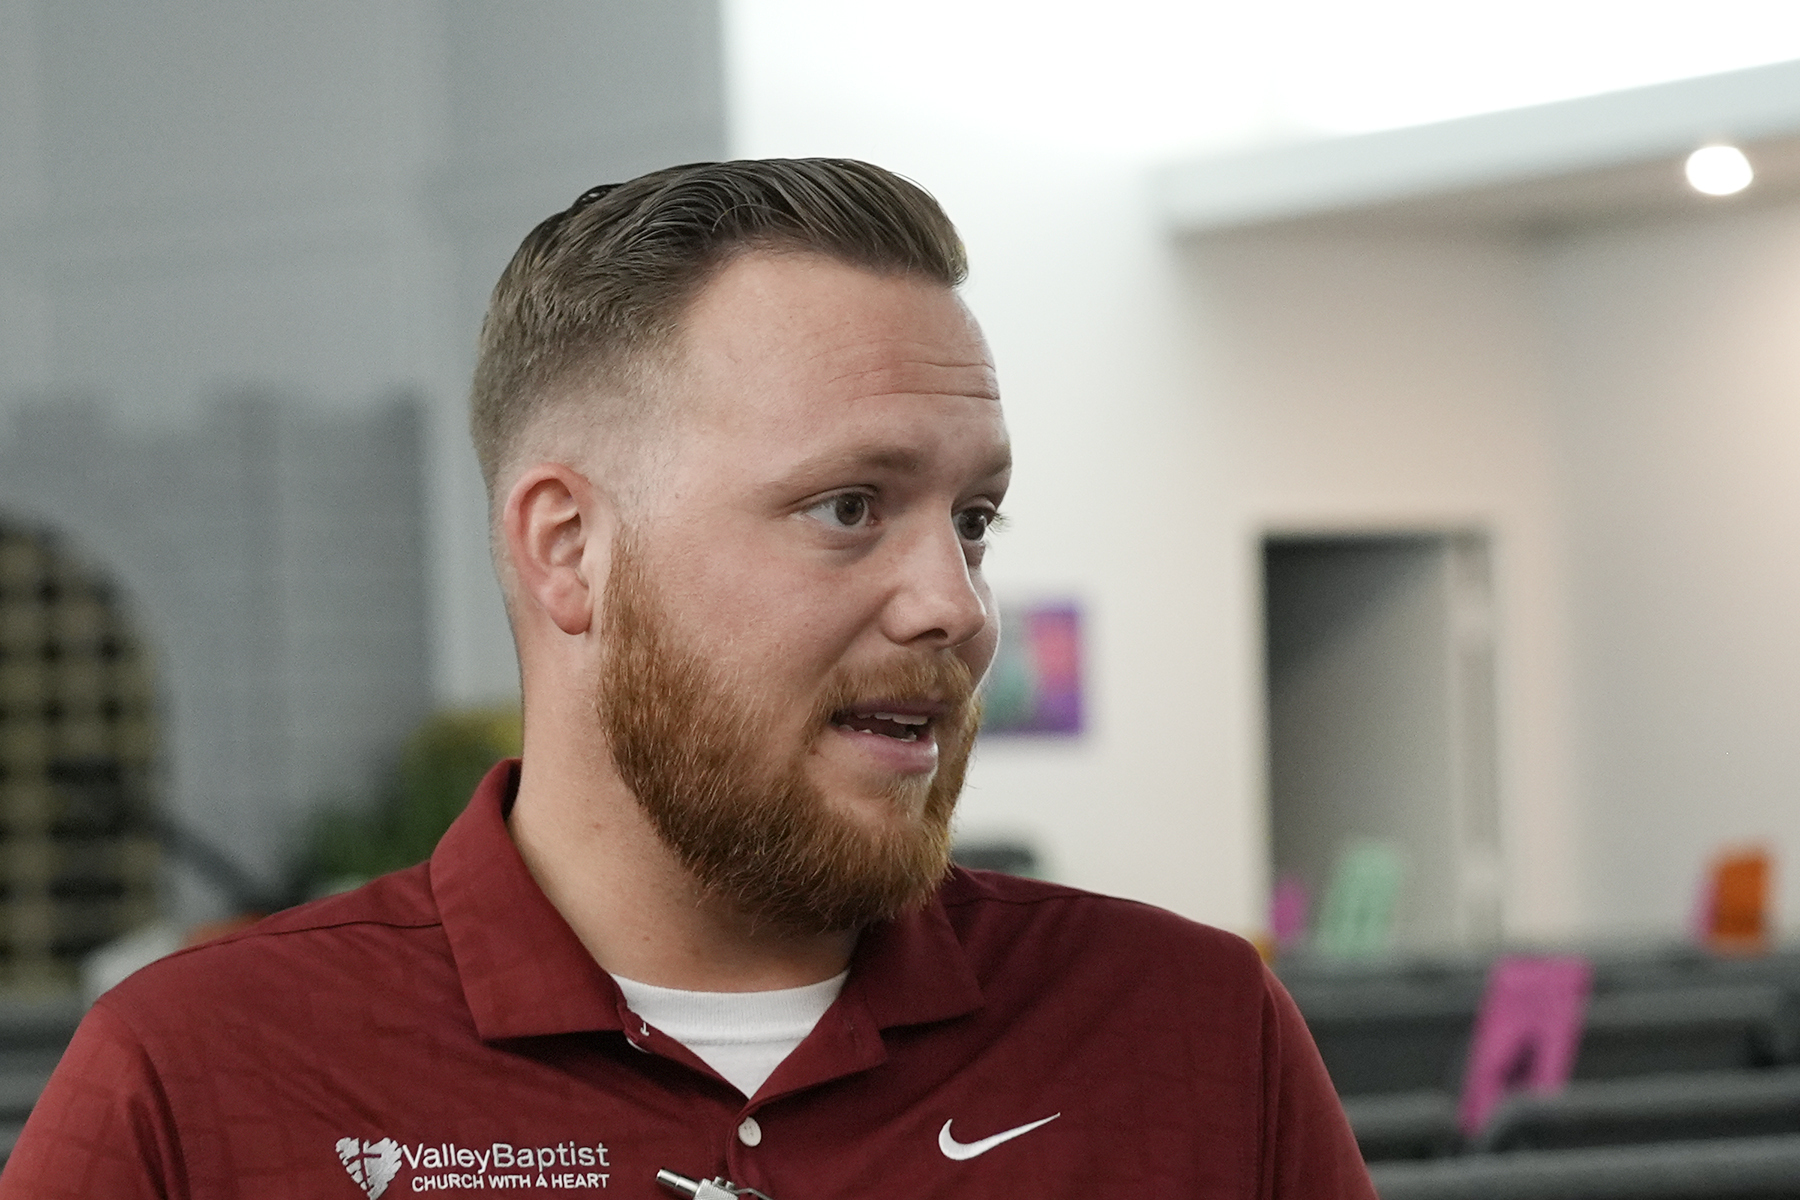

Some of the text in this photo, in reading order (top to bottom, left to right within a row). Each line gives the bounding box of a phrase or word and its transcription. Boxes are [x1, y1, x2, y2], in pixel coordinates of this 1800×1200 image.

[402, 1141, 610, 1174] ValleyBaptist
[411, 1172, 610, 1192] CHURCH WITH A HEART
